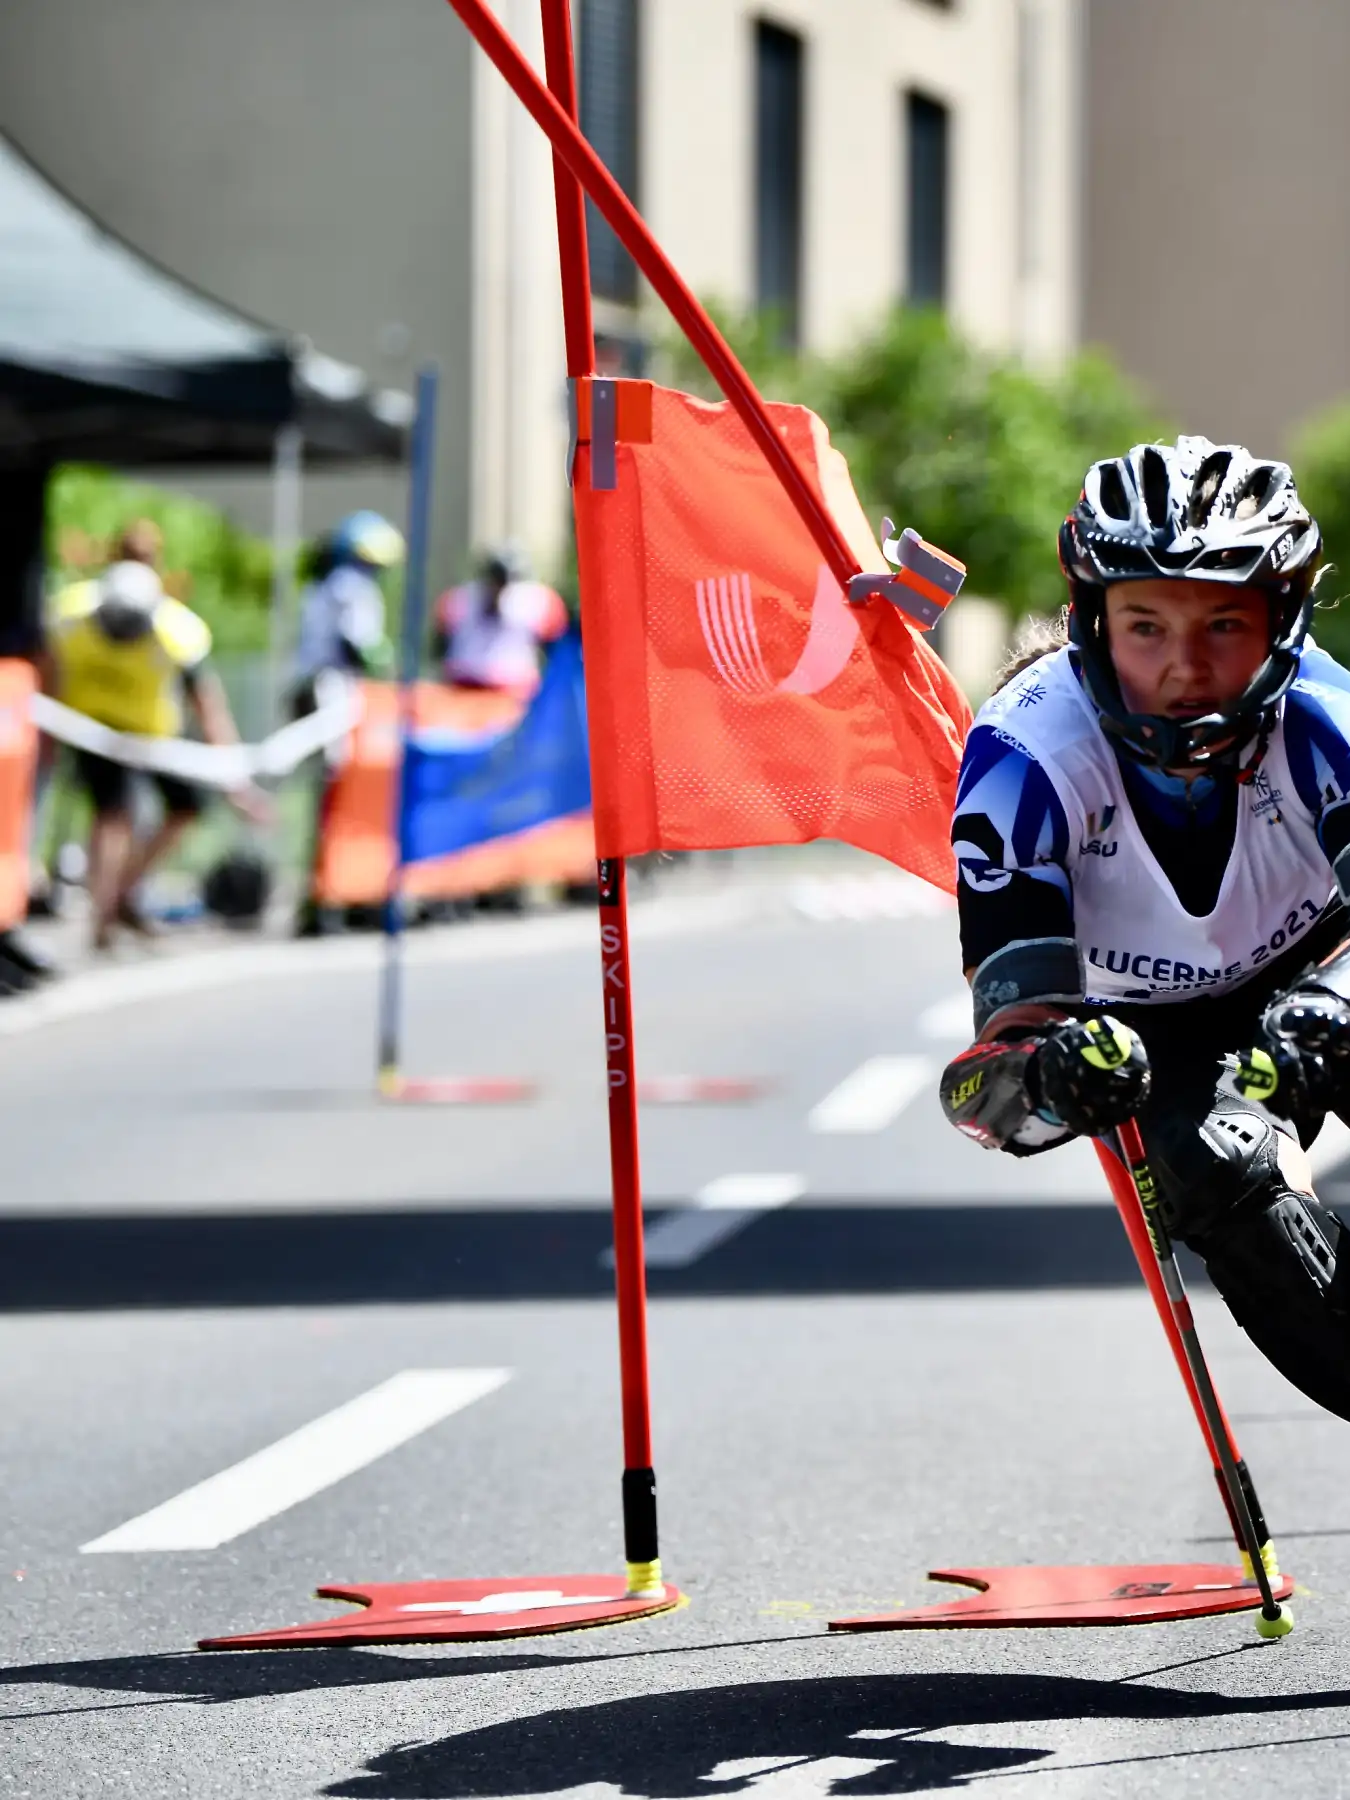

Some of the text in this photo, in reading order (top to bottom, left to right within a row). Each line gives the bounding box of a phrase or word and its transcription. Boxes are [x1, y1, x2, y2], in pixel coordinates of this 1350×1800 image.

[1089, 899, 1324, 983] LUCERNE 2021
[600, 924, 627, 1097] SKIPP
